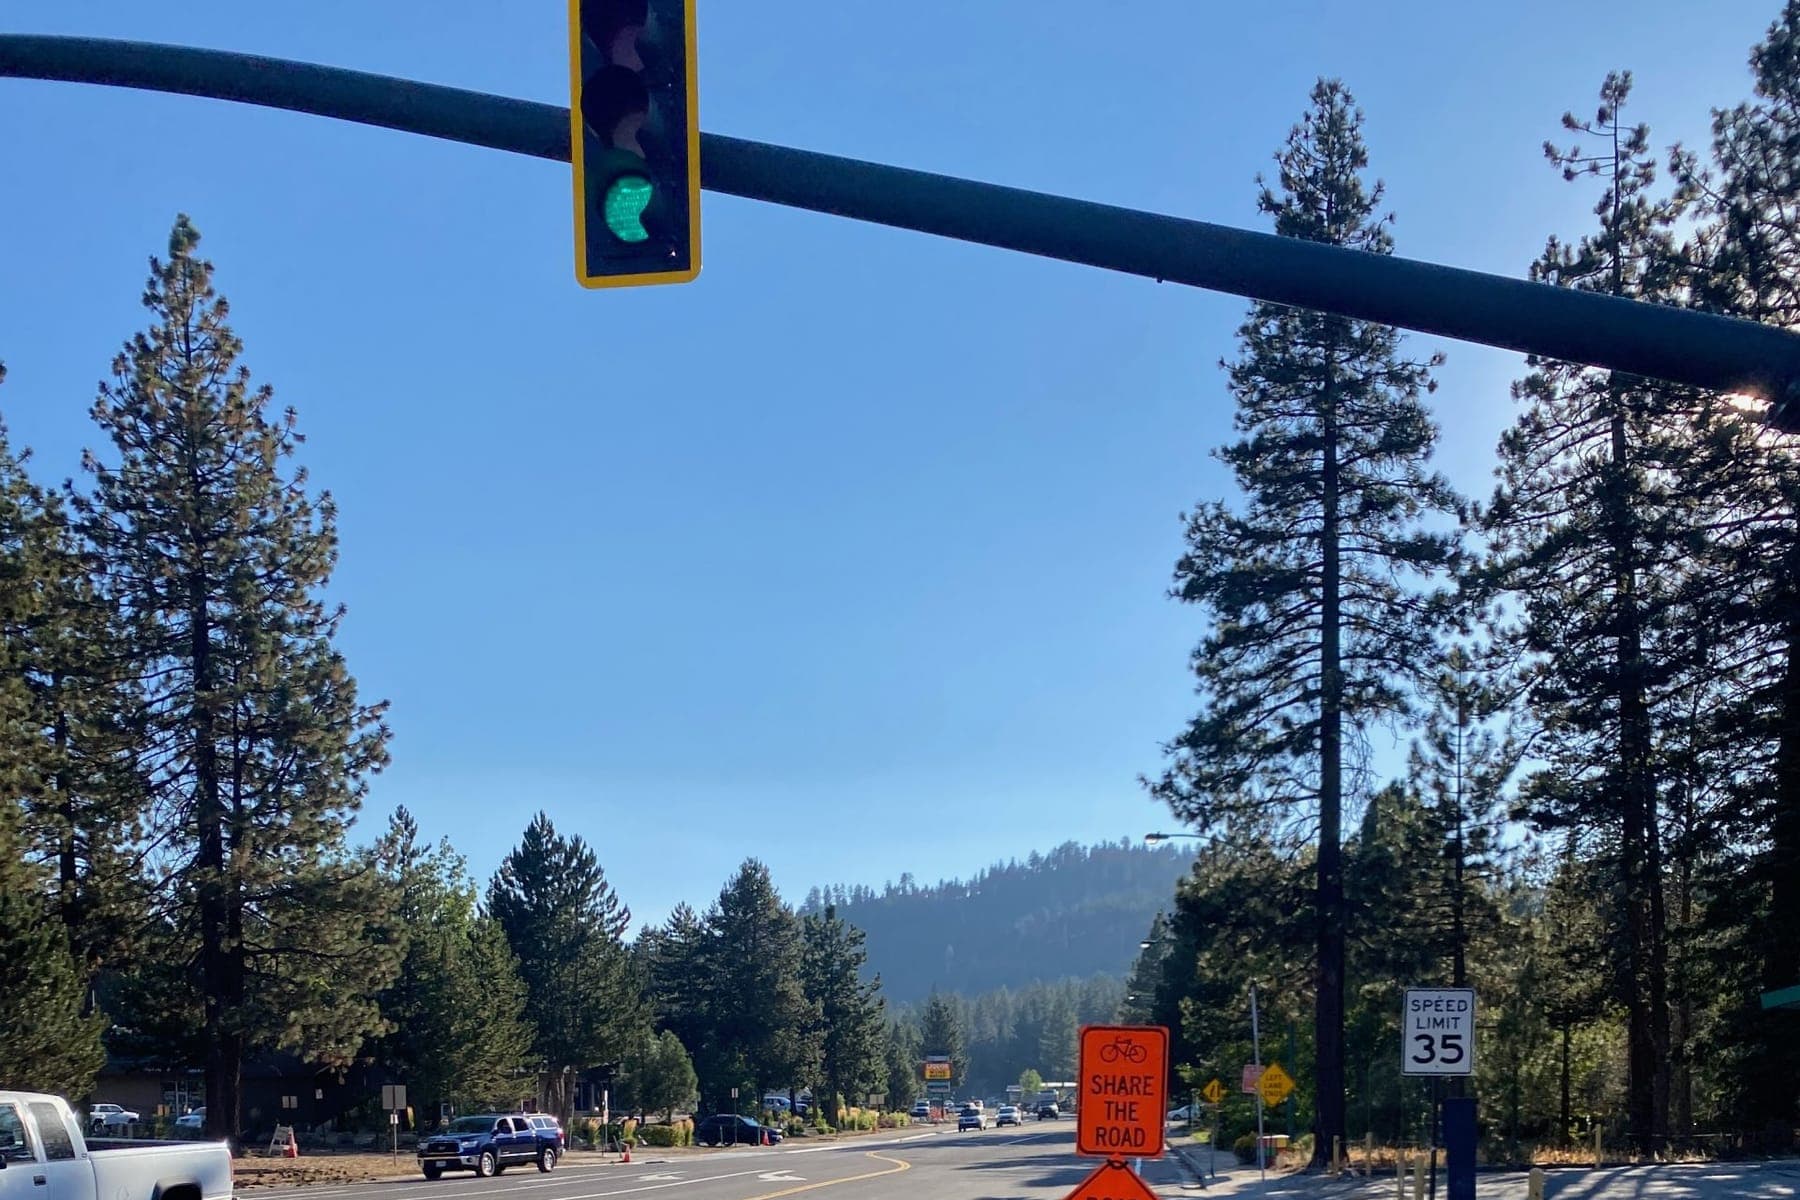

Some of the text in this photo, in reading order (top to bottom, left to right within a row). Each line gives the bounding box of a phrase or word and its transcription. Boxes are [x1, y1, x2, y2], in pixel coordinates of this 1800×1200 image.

[1411, 999, 1468, 1012] SPEED
[1416, 1017, 1461, 1029] LIMIT
[1412, 1034, 1464, 1064] 35
[1091, 1074, 1155, 1096] SHARE
[1104, 1101, 1139, 1121] THE
[1095, 1127, 1146, 1147] ROAD
